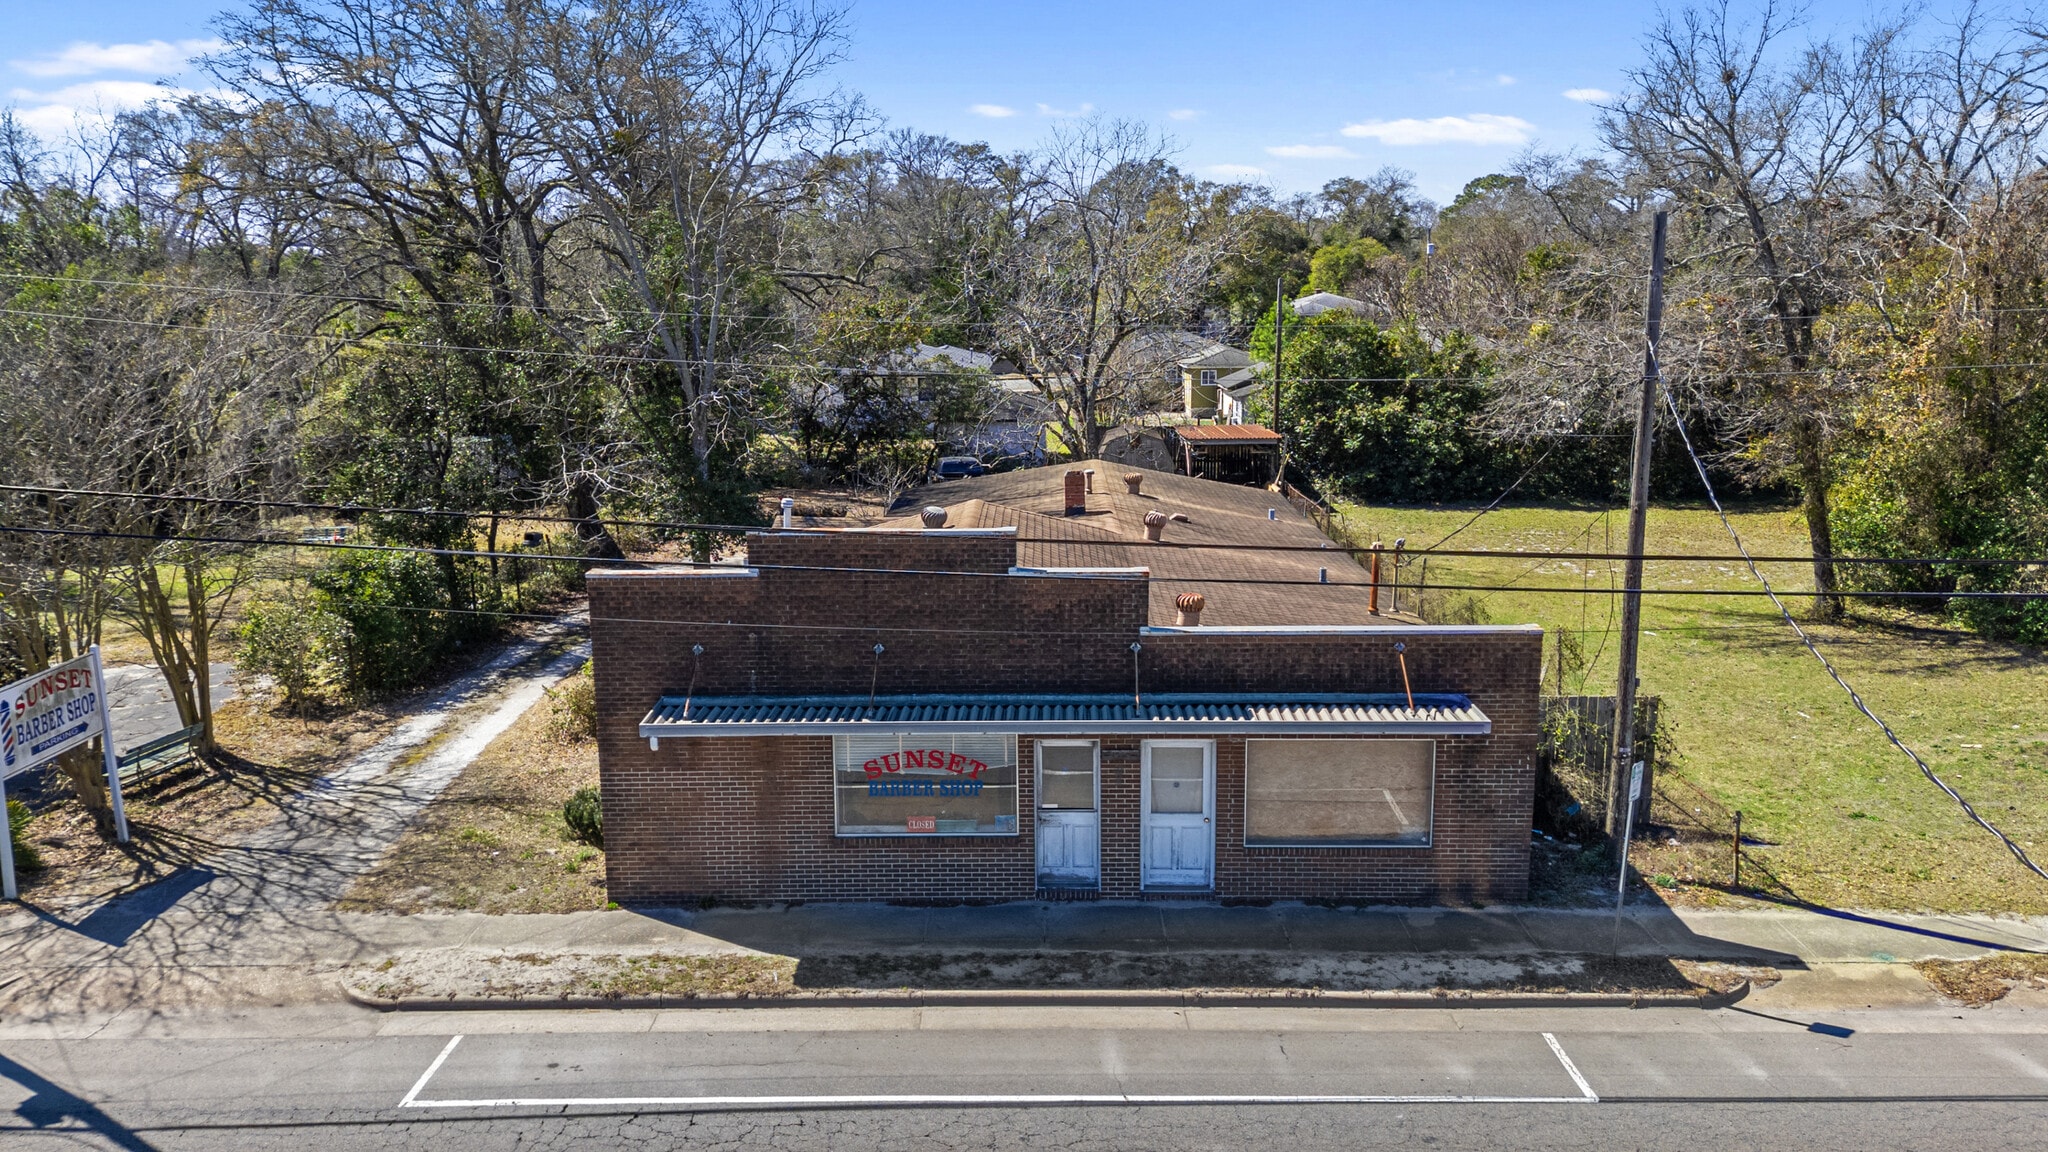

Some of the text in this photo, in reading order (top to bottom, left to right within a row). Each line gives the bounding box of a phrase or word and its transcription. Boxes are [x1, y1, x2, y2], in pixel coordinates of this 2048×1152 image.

[15, 668, 92, 720] SUNSET
[16, 692, 96, 745] BARBER SHOP
[38, 727, 80, 751] PARKING
[863, 749, 988, 780] SUNSET
[868, 780, 984, 797] BARBER SHOP
[908, 819, 935, 829] CLOSED
